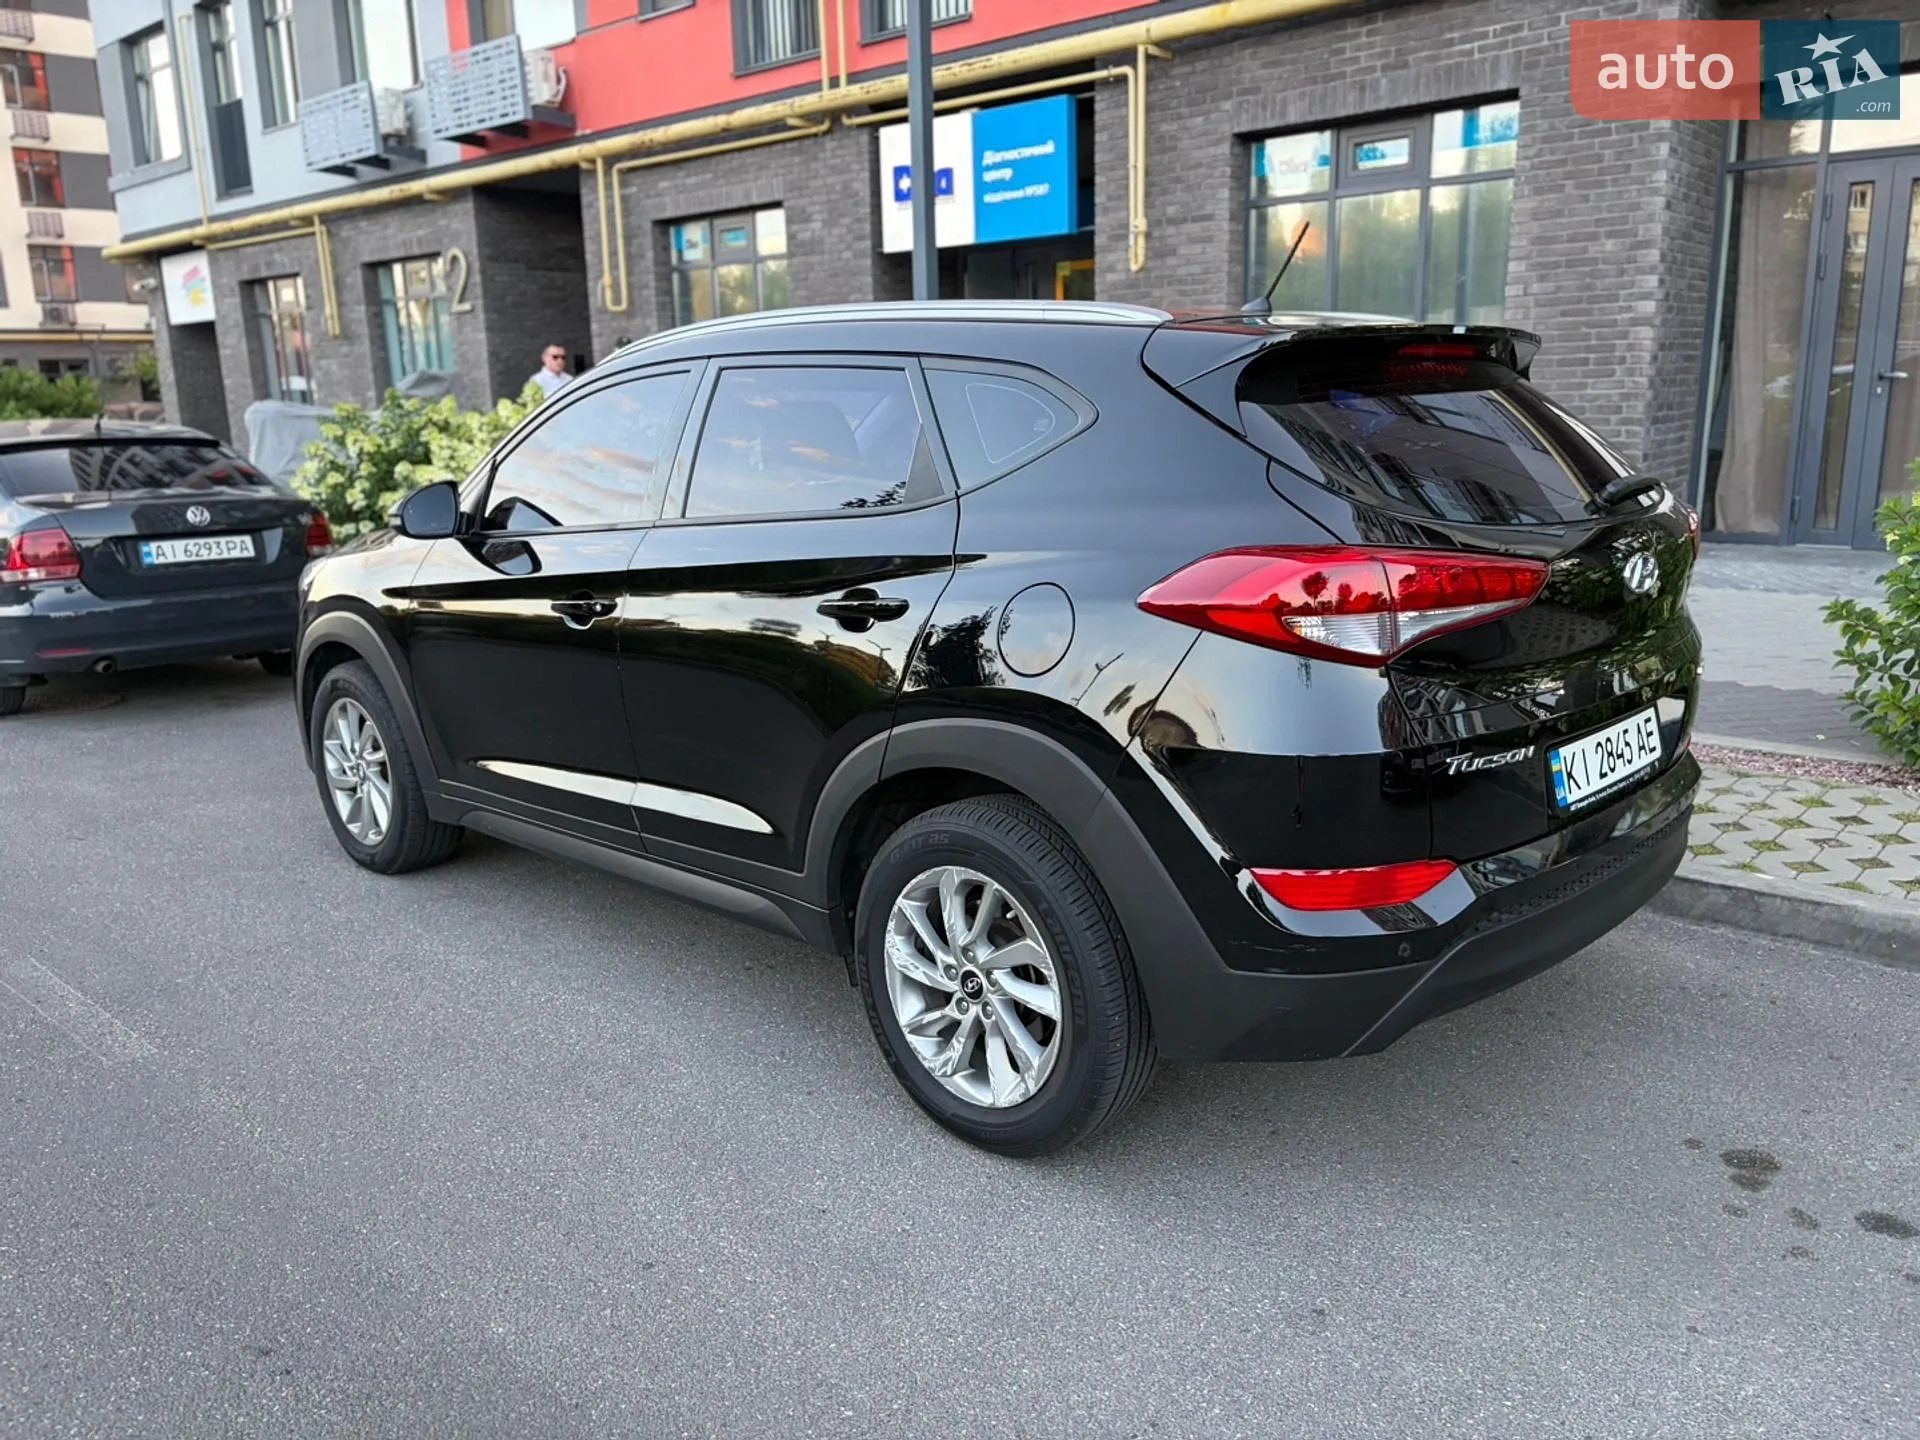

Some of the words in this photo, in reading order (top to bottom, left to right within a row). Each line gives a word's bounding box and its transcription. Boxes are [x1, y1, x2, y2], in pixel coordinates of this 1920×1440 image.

[444, 246, 473, 313] 2
[183, 541, 224, 558] 6293
[226, 539, 251, 556] PA
[1562, 749, 1591, 796] KI
[1594, 727, 1635, 780] 2845
[1636, 716, 1658, 760] AE
